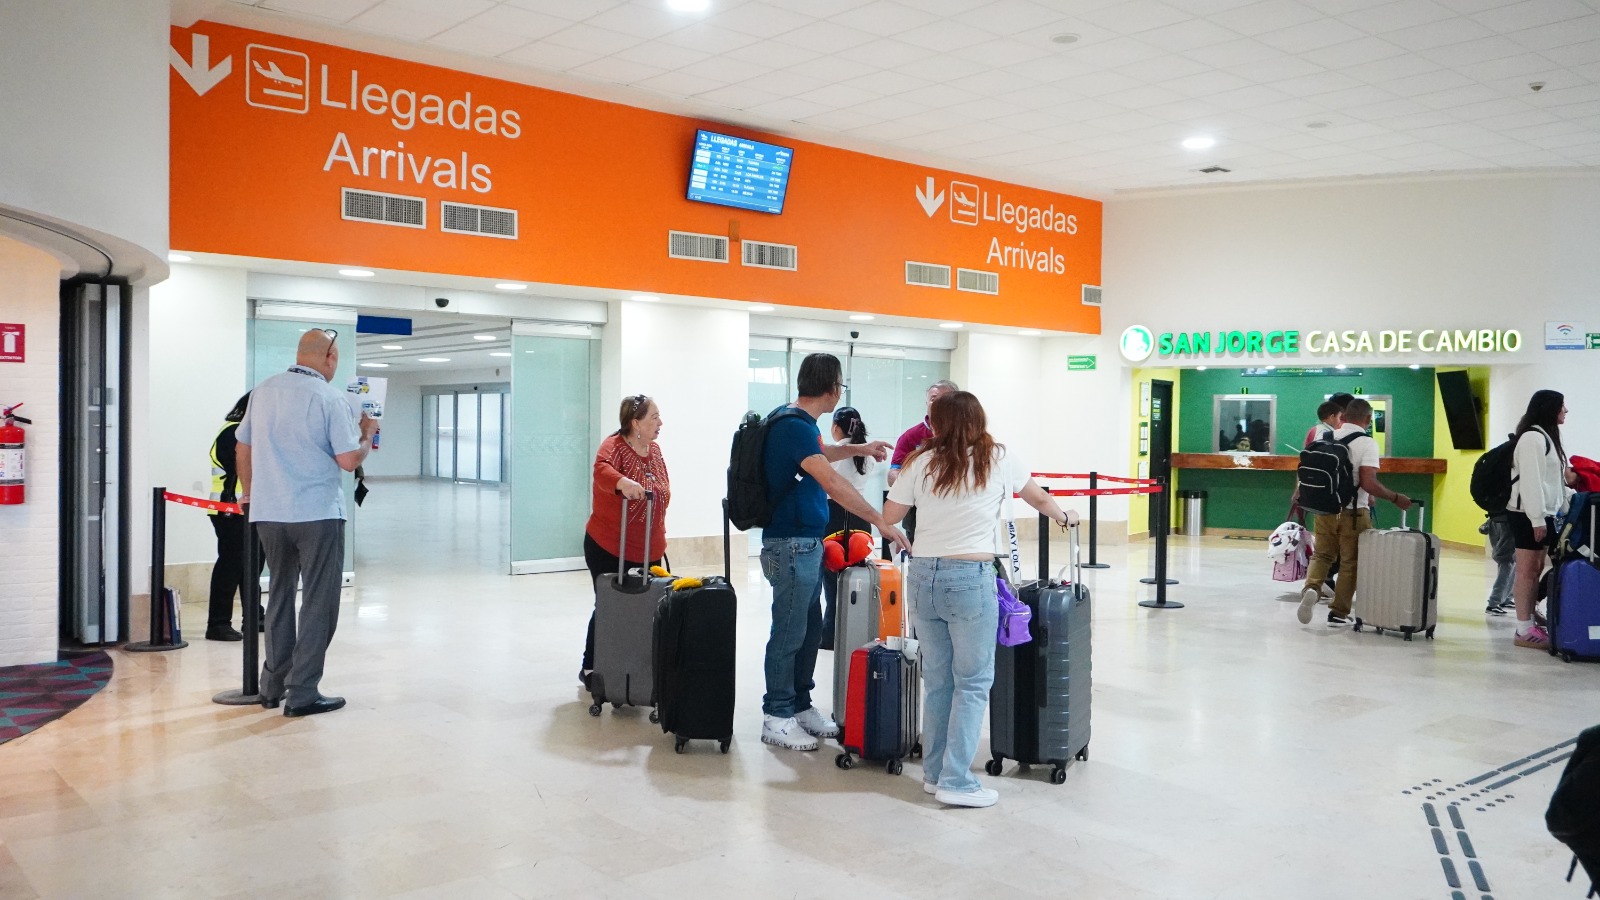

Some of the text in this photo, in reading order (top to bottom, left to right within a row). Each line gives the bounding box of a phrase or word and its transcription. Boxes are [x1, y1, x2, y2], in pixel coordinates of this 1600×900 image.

[320, 63, 521, 139] Llegadas
[710, 135, 738, 147] LLEGADAS
[322, 131, 492, 194] Arrivals
[983, 191, 1078, 235] Llegadas
[986, 236, 1065, 275] Arrivals
[1158, 329, 1522, 355] SAN JORGE CASA DE CAMBIO
[1012, 549, 1020, 572] LOLA
